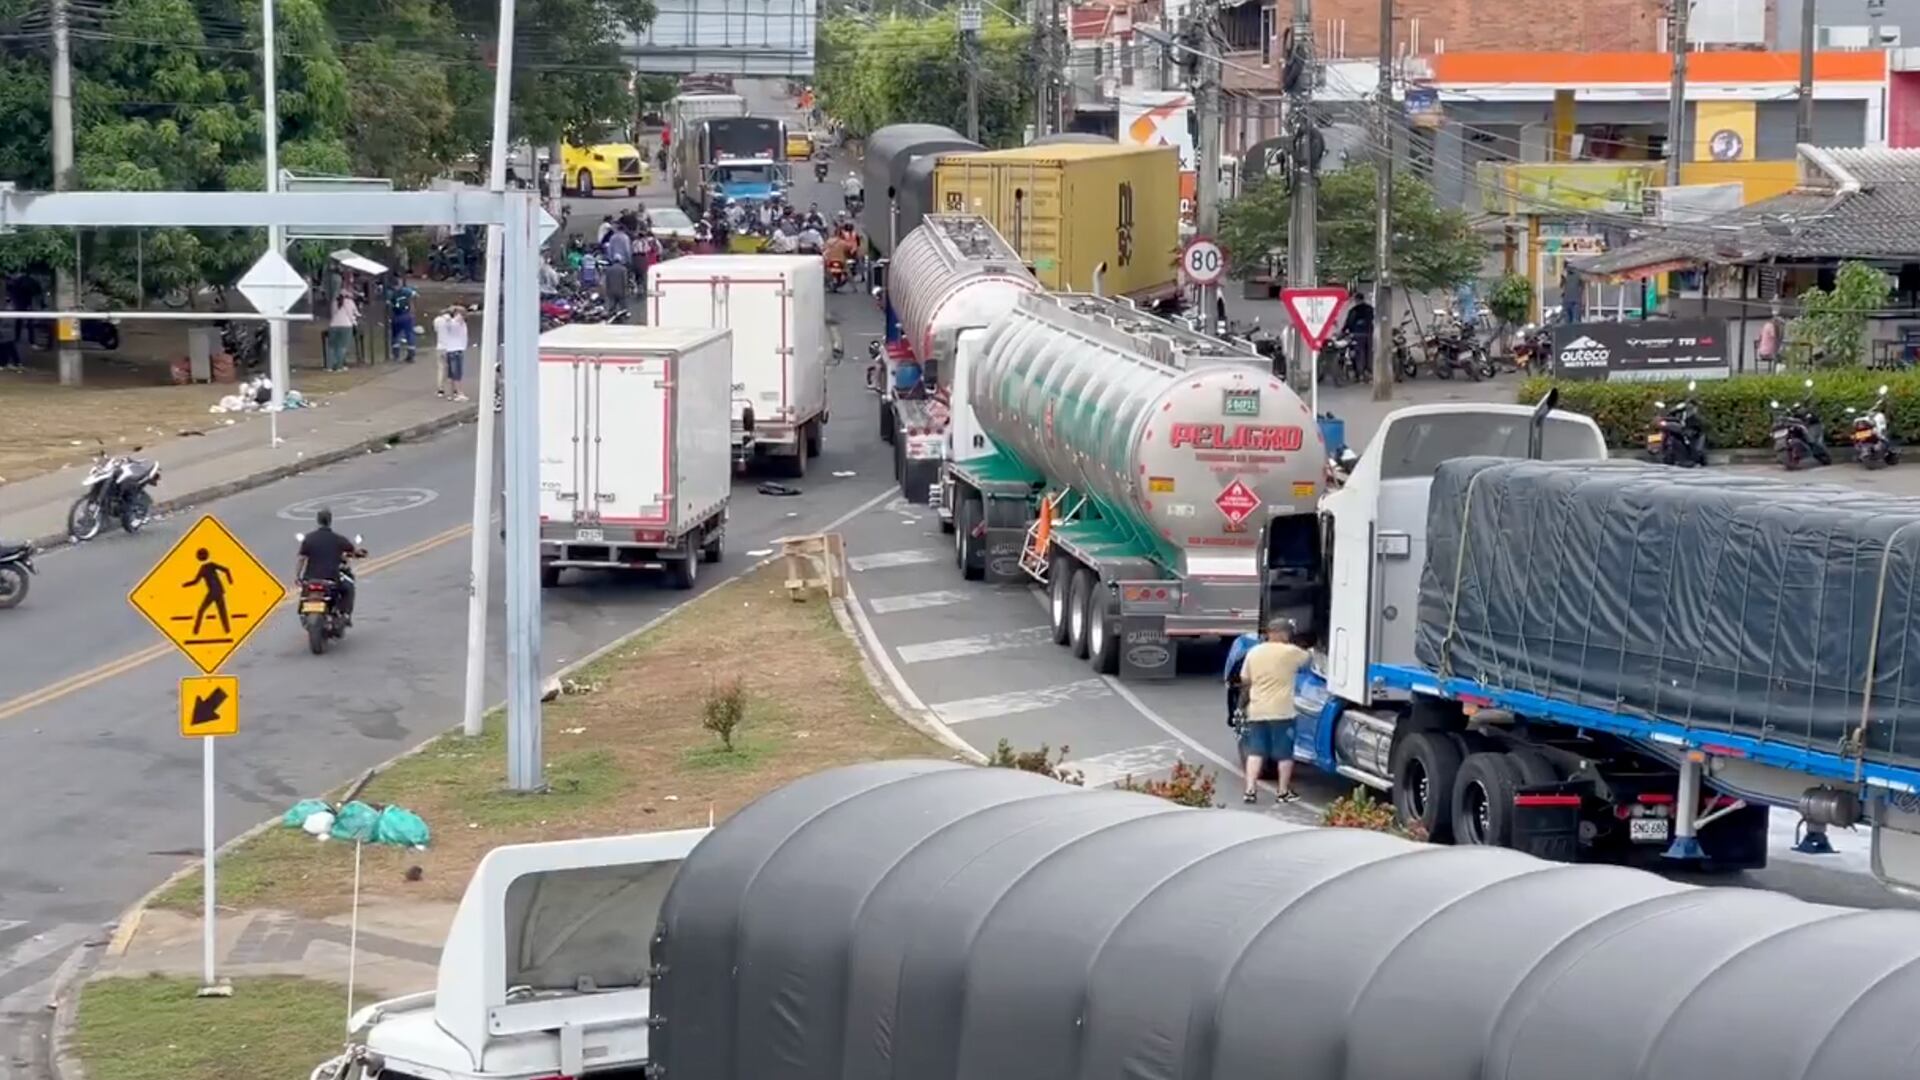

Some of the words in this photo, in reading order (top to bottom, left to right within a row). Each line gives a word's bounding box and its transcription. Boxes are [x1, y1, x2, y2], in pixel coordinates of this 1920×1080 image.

[1191, 249, 1218, 272] 80
[1560, 349, 1610, 362] auteco
[1171, 422, 1303, 451] PELIGRO
